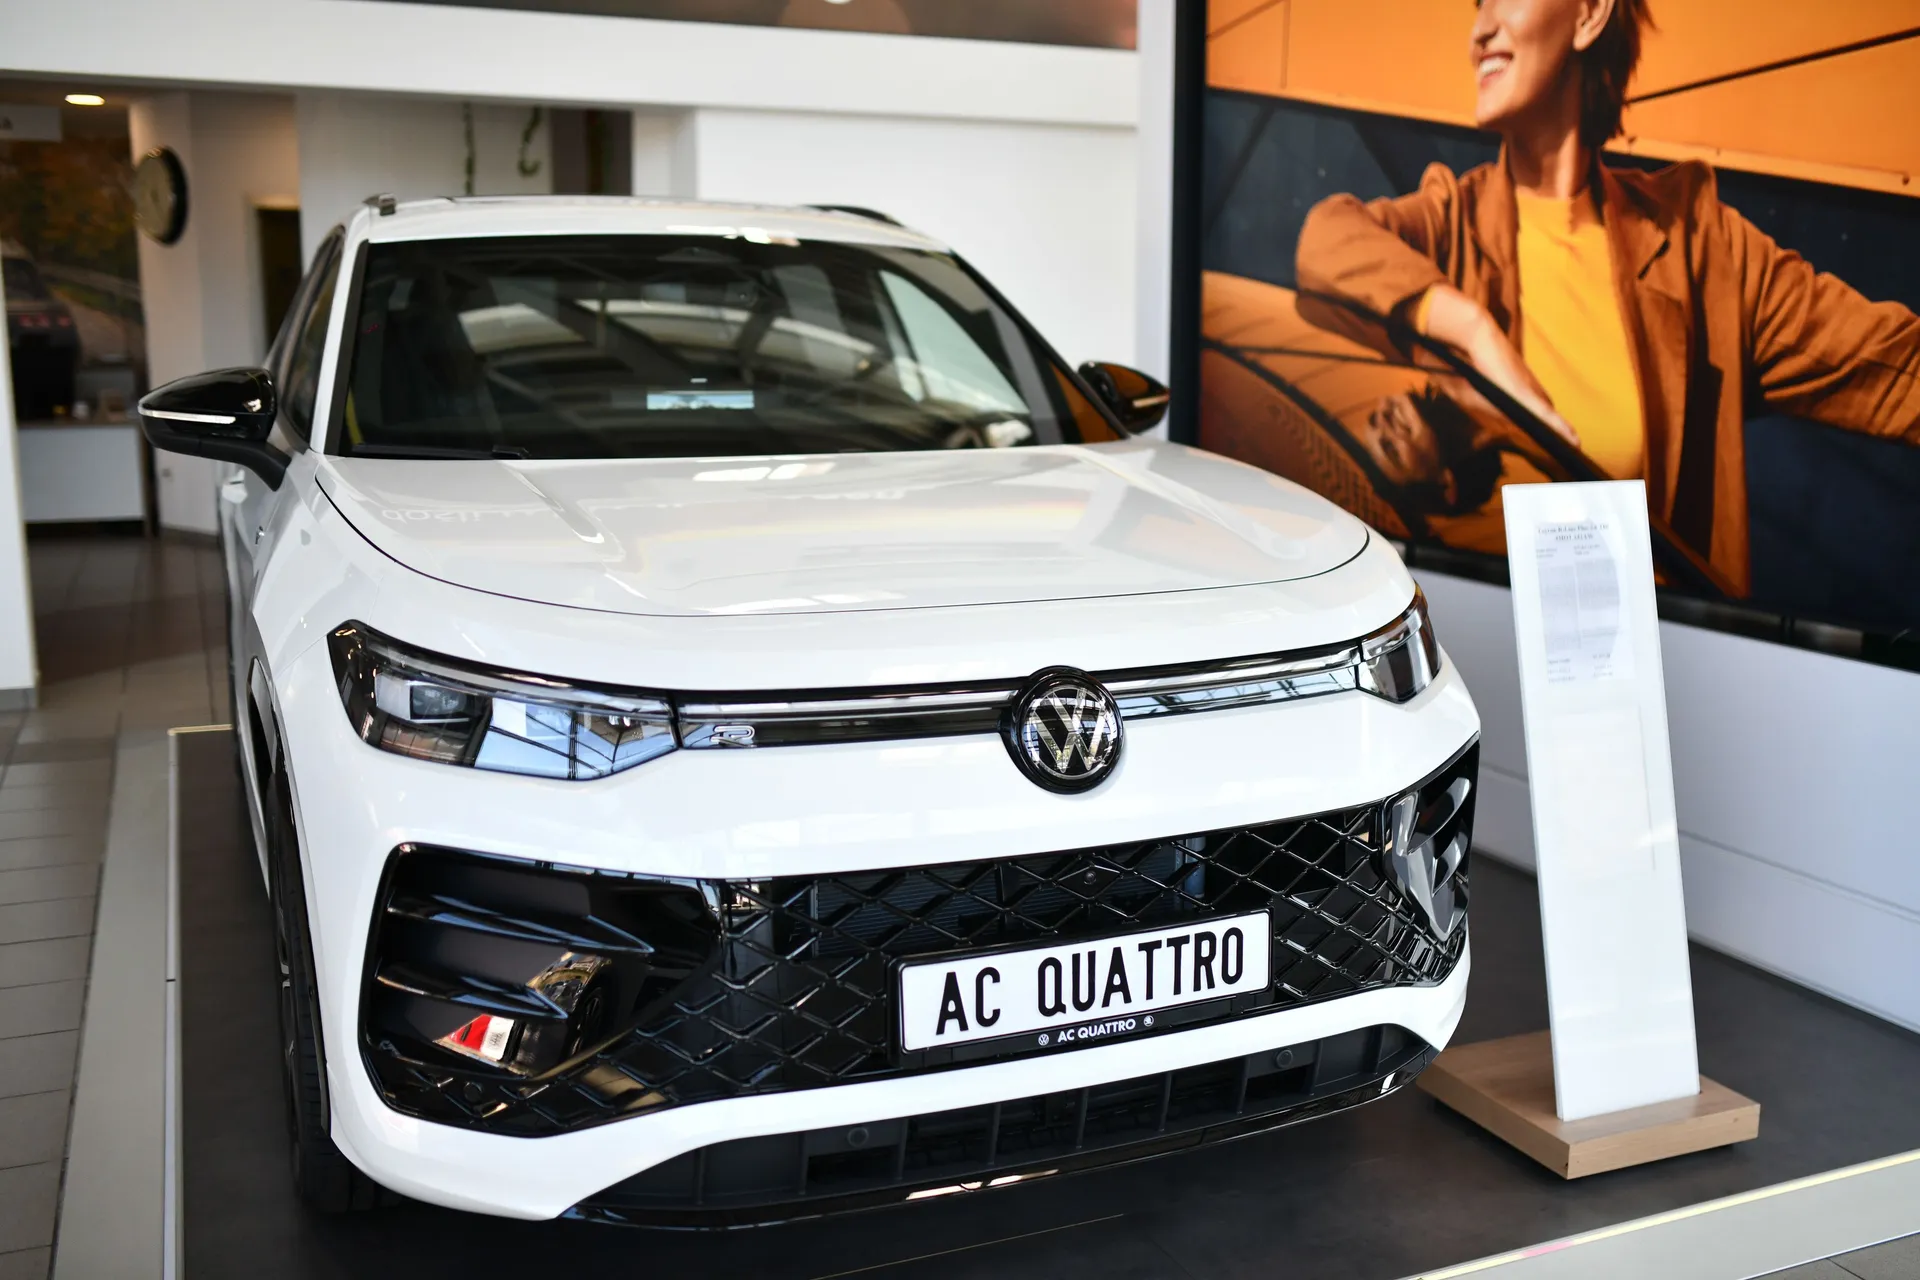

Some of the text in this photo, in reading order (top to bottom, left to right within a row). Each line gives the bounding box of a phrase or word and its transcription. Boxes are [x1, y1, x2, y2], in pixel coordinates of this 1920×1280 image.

[1022, 684, 1118, 780] VW
[936, 926, 1244, 1036] AC QUATTRO
[1057, 1028, 1075, 1043] AC
[1077, 1018, 1136, 1039] QUATTRO
